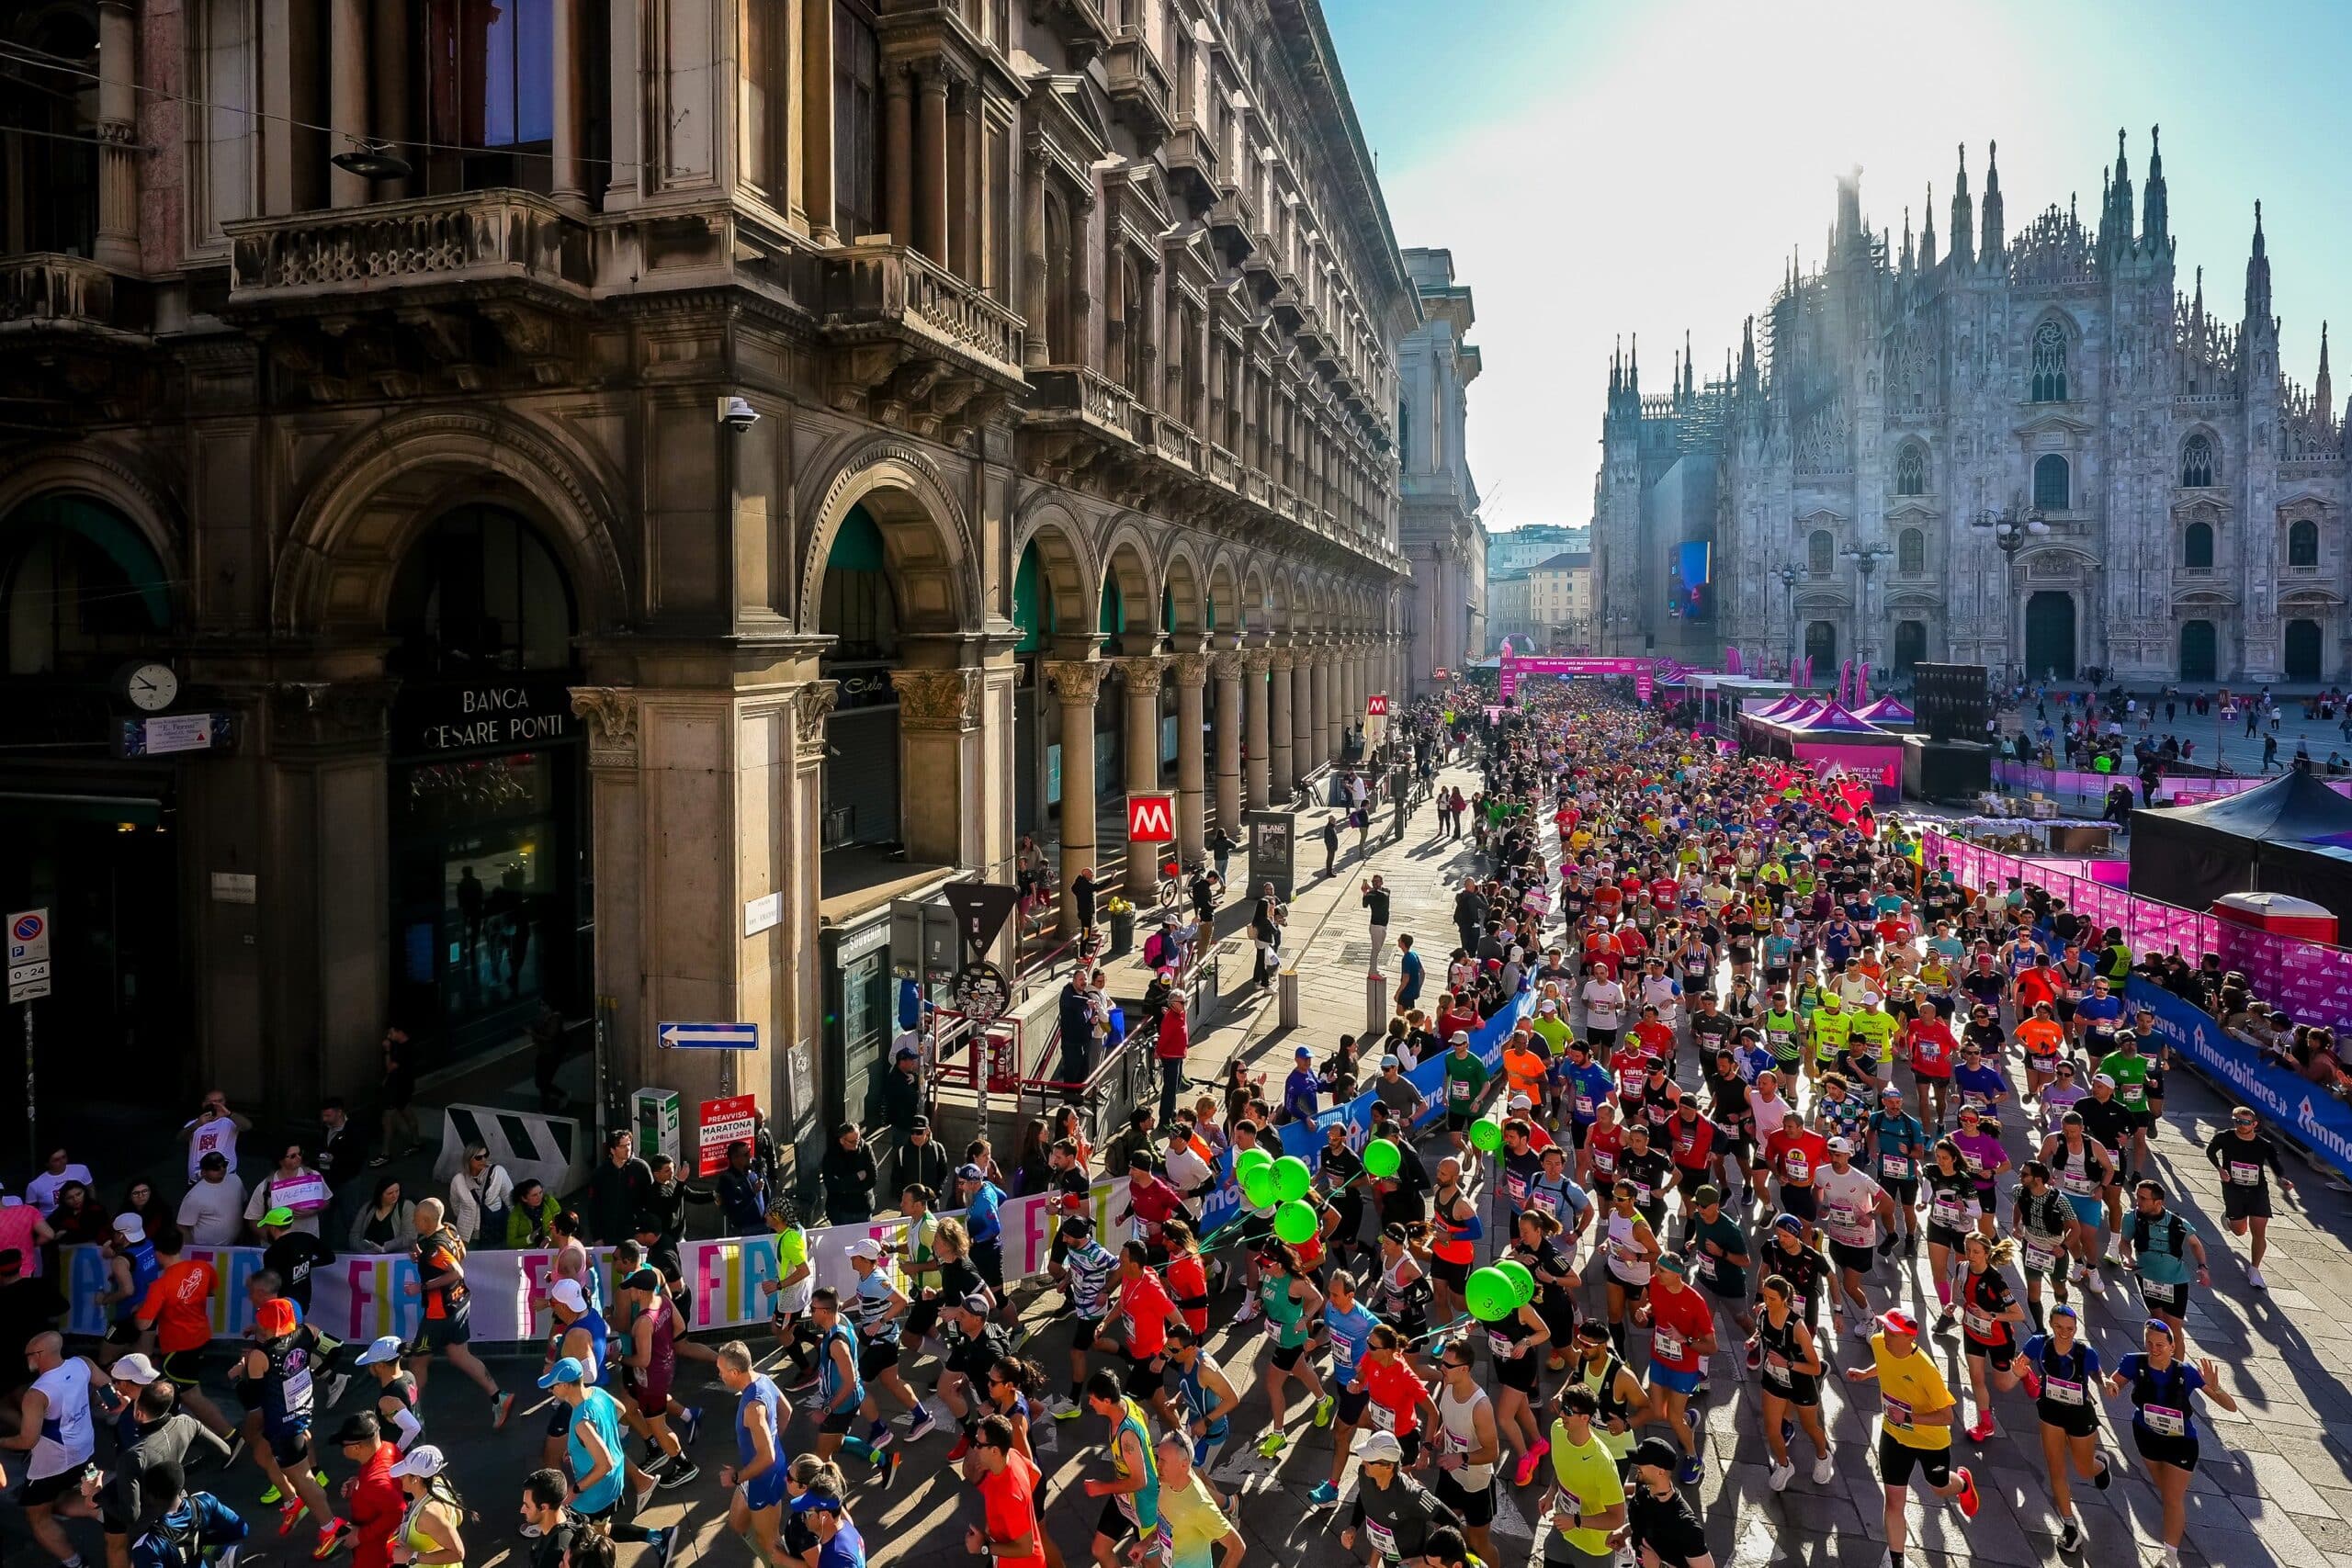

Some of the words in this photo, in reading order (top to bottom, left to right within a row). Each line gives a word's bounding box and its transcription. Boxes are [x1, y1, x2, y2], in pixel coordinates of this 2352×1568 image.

[463, 688, 529, 713] BANCA
[1370, 700, 1385, 712] M
[424, 720, 500, 749] CESARE
[510, 714, 562, 740] PONTI
[1132, 805, 1170, 834] M
[849, 923, 882, 951] SOUVENIR
[30, 966, 45, 976] 24
[707, 1111, 748, 1123] PREAVVISO
[703, 1120, 752, 1135] MARATONA
[710, 1133, 735, 1142] APRILE
[735, 1129, 752, 1137] 2025
